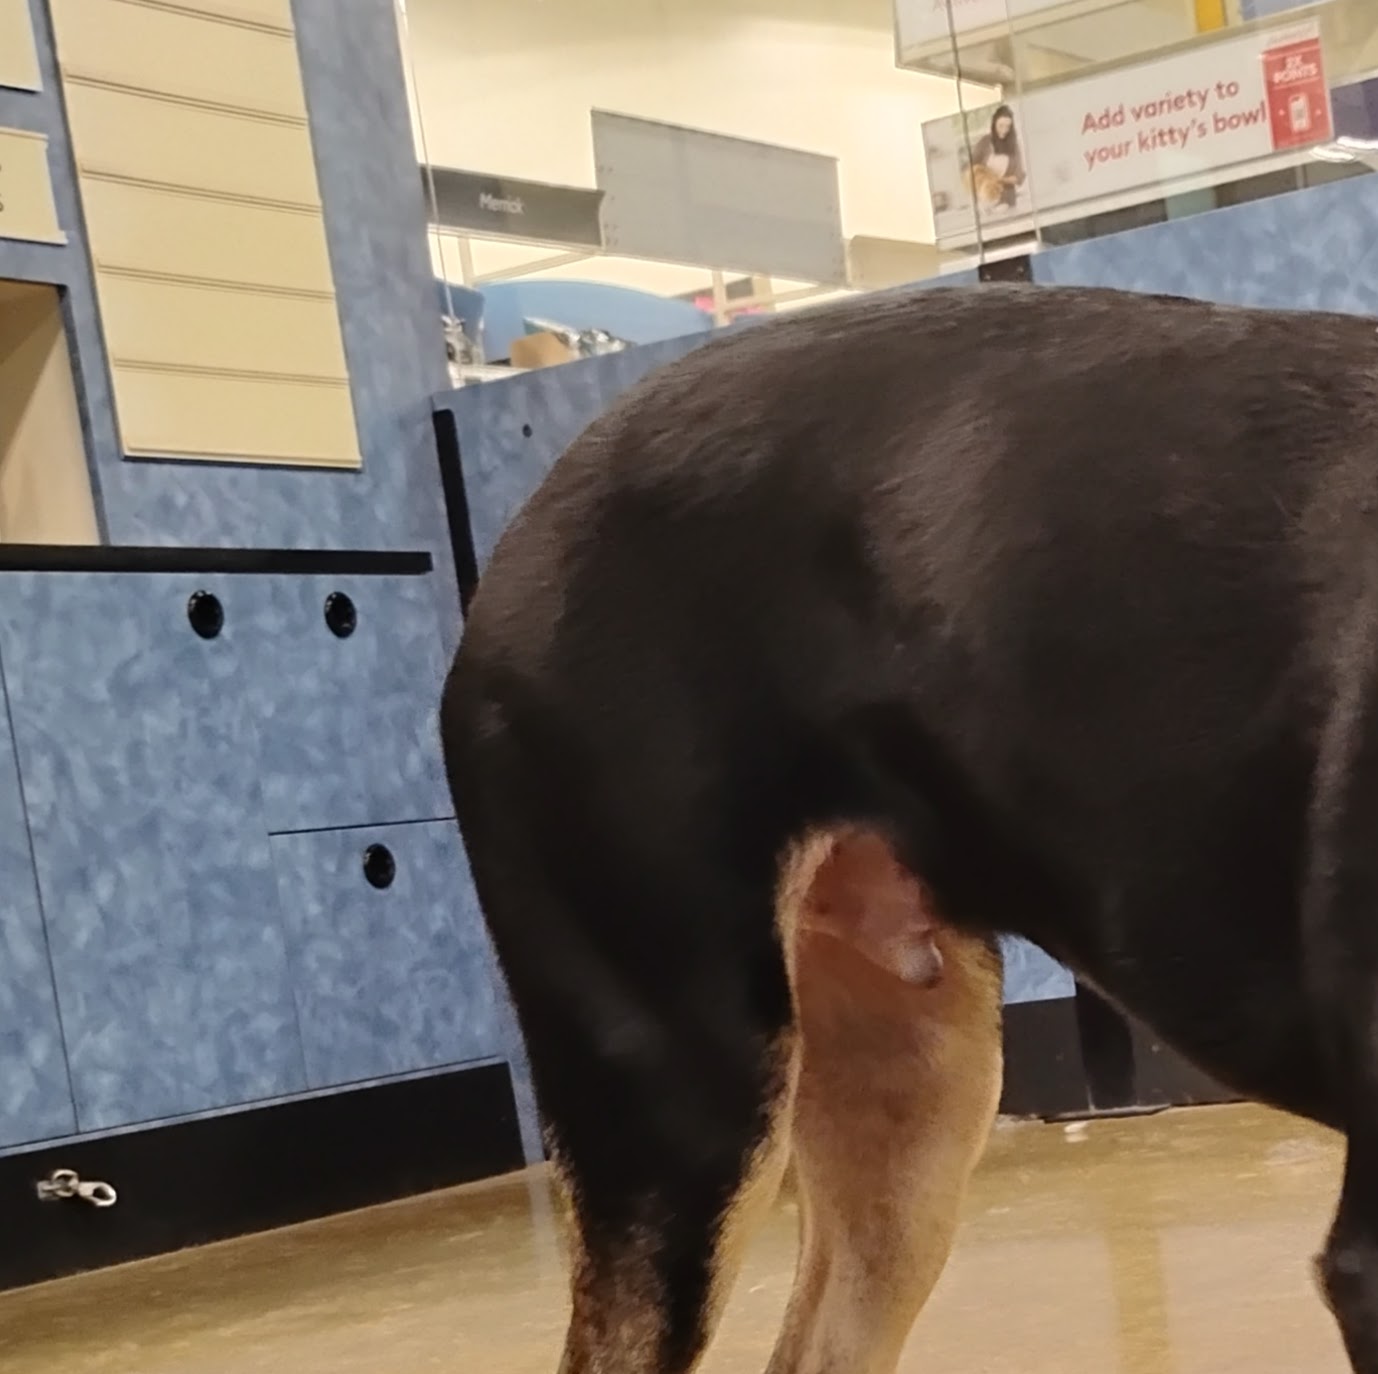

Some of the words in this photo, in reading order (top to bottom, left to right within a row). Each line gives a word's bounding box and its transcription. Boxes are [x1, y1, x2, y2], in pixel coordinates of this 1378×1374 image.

[1081, 104, 1126, 135] Add
[1131, 87, 1209, 122] variety
[1214, 78, 1240, 99] to
[1083, 139, 1132, 172] your
[1137, 117, 1207, 153] kitty's
[1213, 99, 1267, 134] bowl
